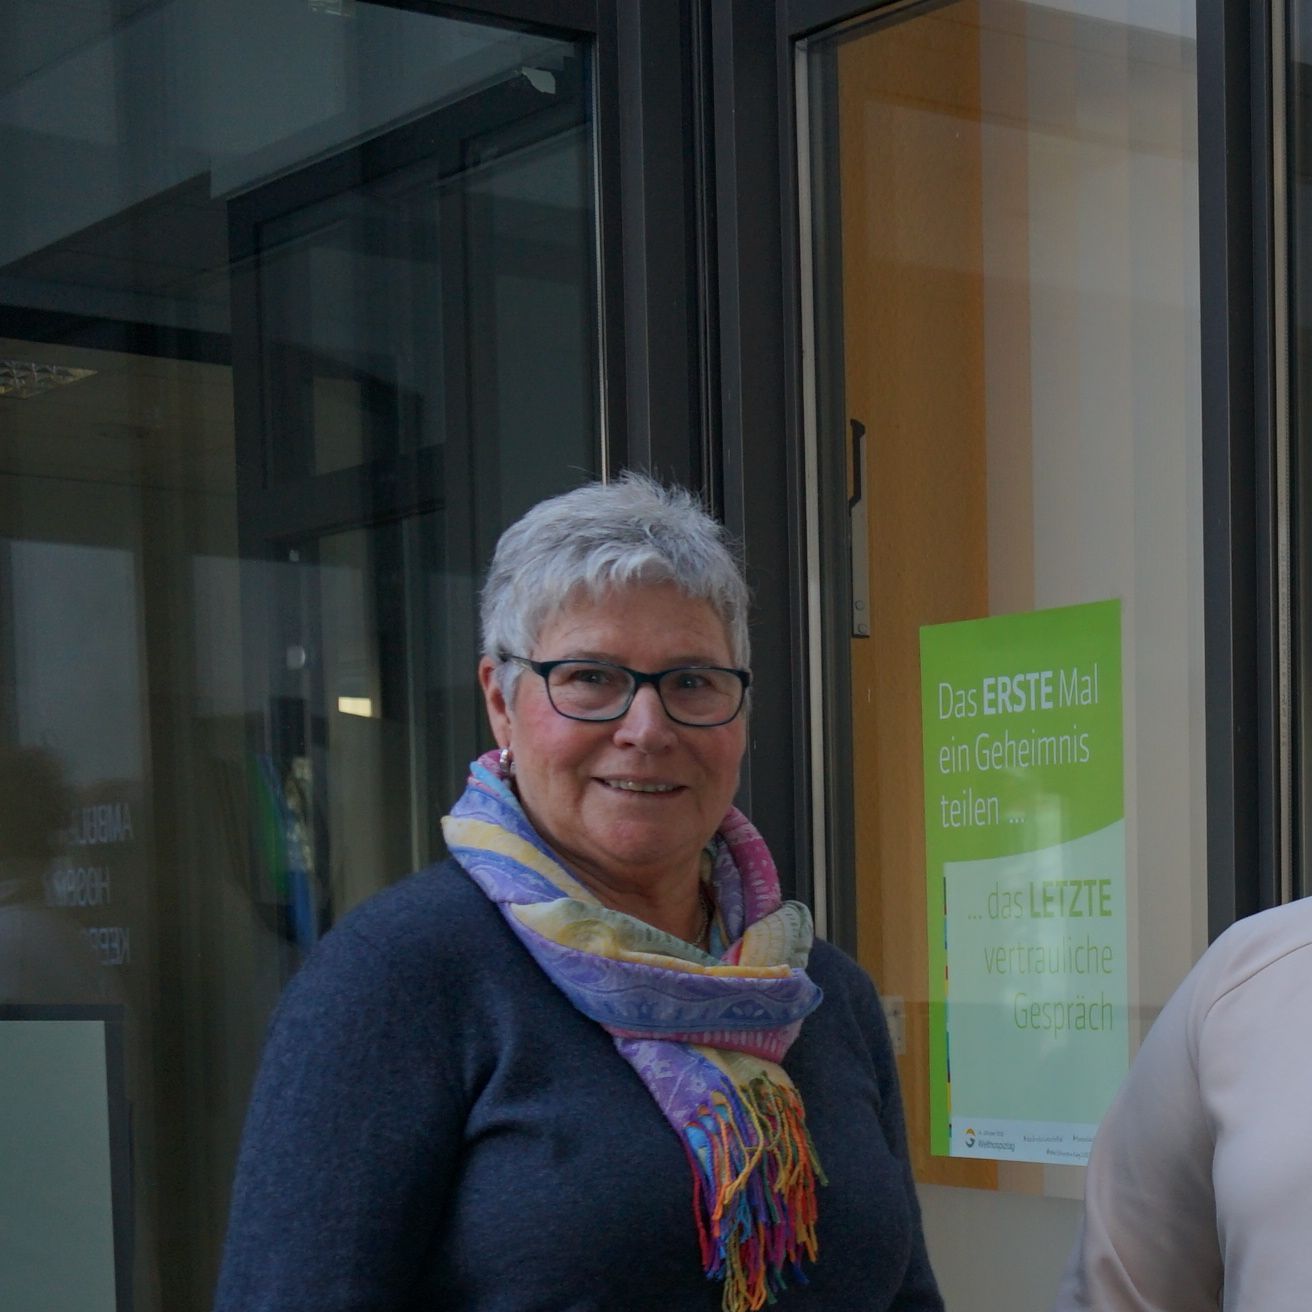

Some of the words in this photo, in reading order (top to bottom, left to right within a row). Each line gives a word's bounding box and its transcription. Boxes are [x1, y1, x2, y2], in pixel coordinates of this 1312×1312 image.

[939, 683, 977, 720] Das
[983, 671, 1053, 715] ERSTE
[1059, 663, 1098, 708] Mal
[939, 736, 970, 774] ein
[975, 724, 1090, 771] Geheimnis
[940, 787, 999, 828] teilen
[988, 881, 1023, 920] das
[1029, 879, 1112, 918] LETZTE
[984, 934, 1113, 975] vertrauliche
[1014, 992, 1113, 1040] Gespräch
